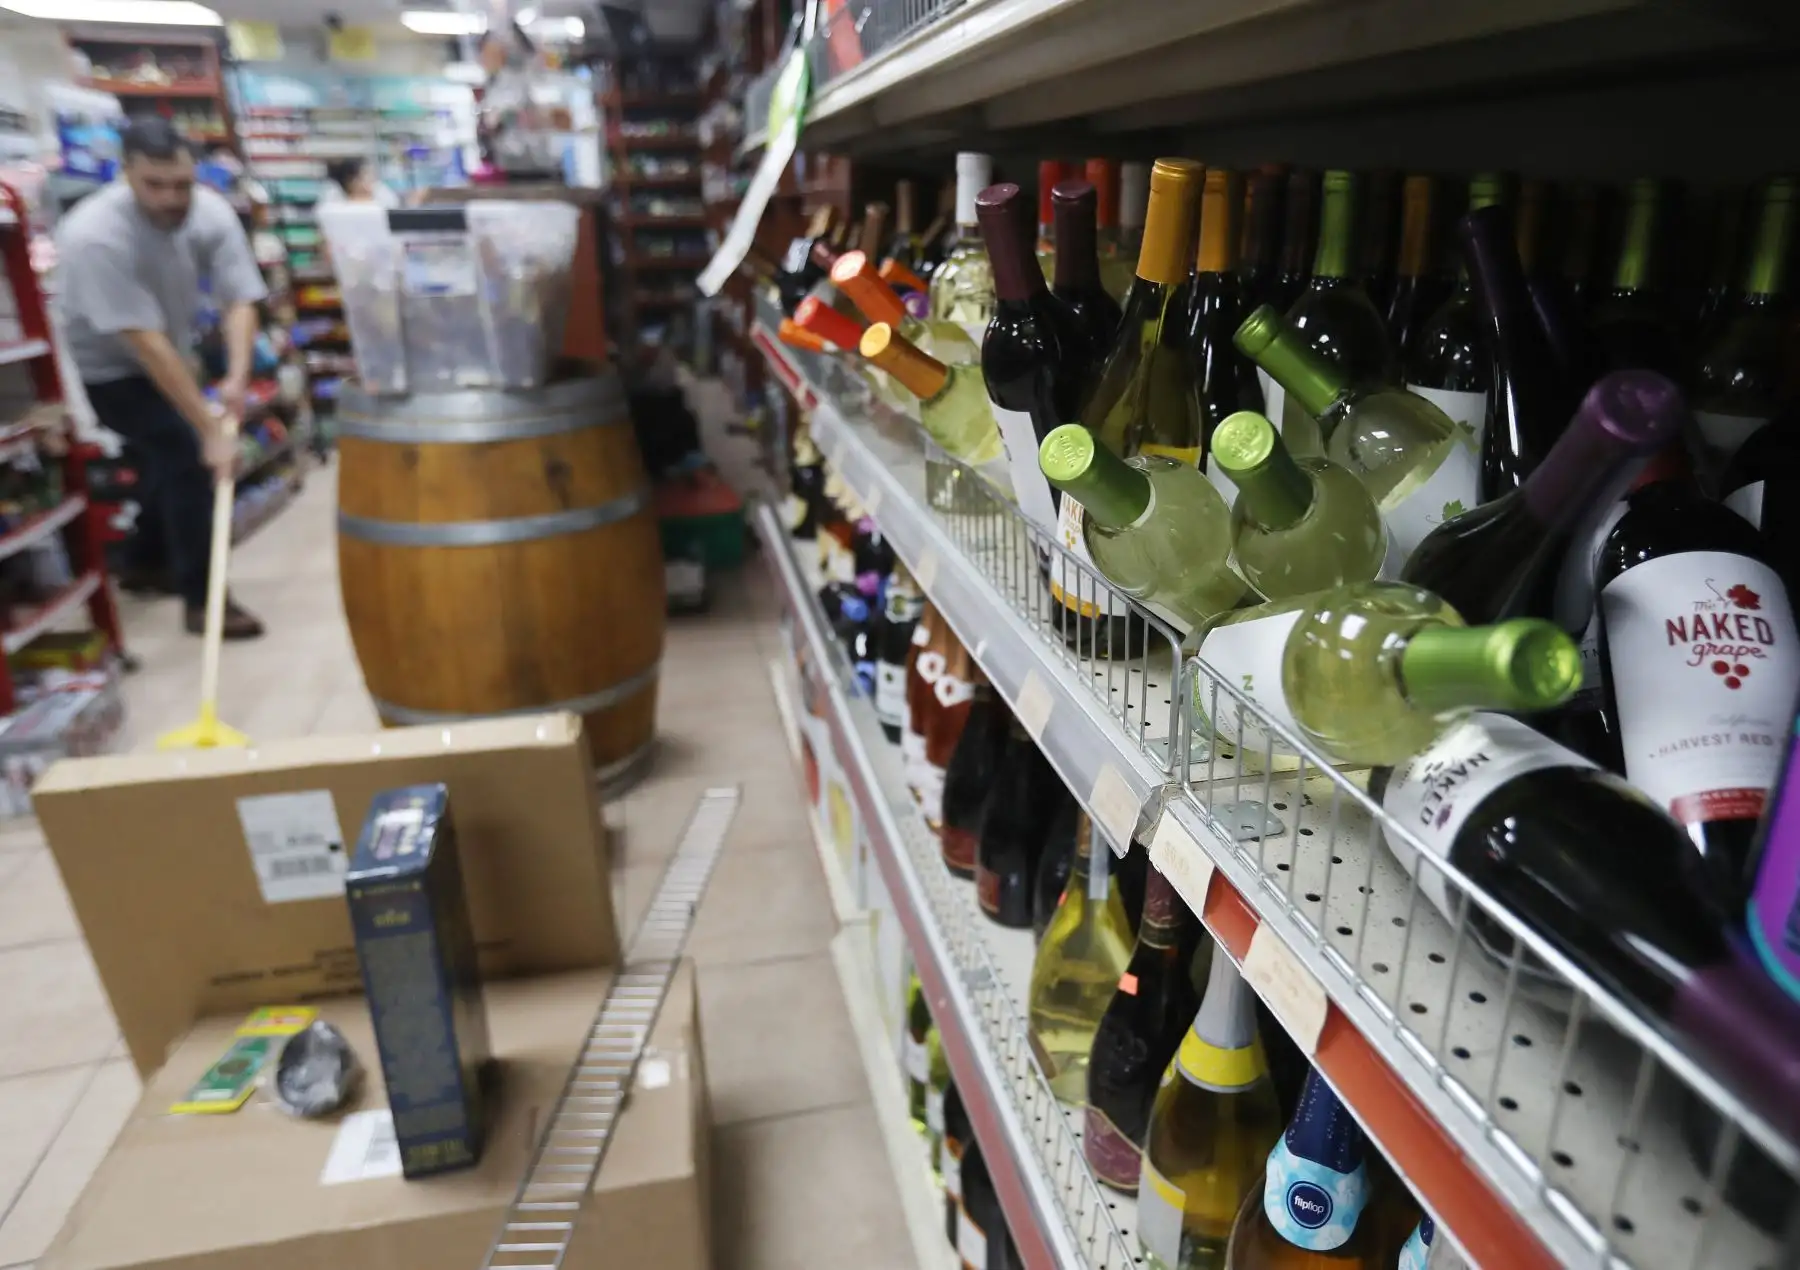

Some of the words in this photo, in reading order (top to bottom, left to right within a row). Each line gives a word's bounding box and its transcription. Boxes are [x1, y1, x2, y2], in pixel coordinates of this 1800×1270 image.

[1665, 612, 1775, 647] NAKED
[1686, 641, 1768, 668] grape
[1658, 733, 1732, 756] HARVEST
[1739, 733, 1775, 747] RED
[1420, 752, 1491, 826] NAKED
[1294, 1195, 1325, 1215] flipflop
